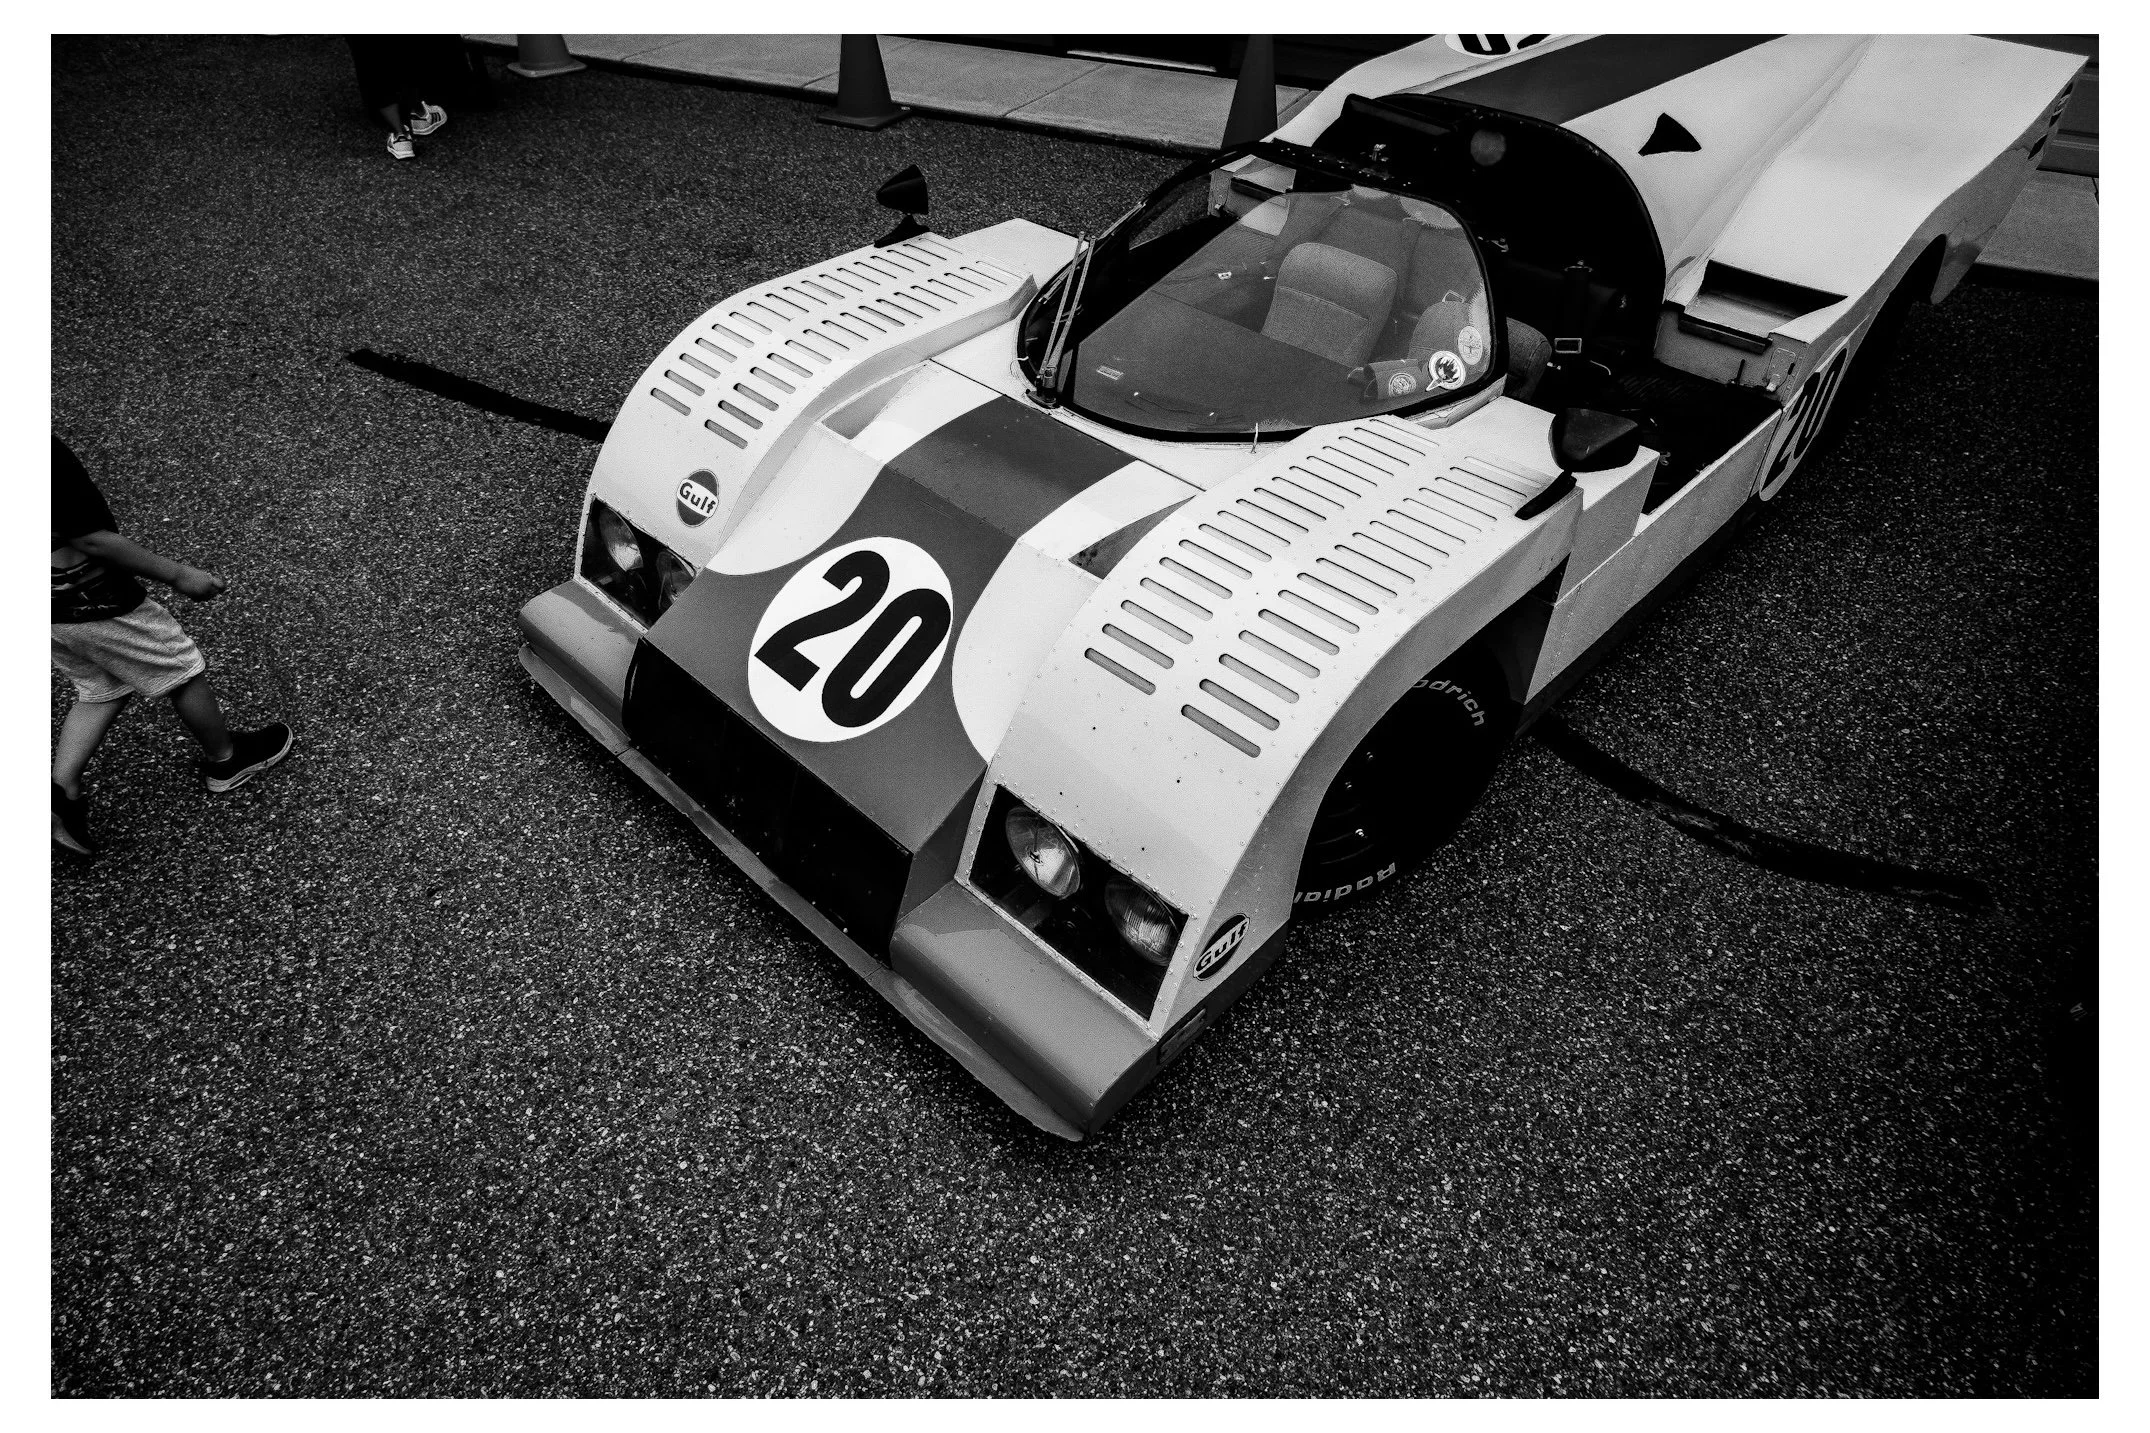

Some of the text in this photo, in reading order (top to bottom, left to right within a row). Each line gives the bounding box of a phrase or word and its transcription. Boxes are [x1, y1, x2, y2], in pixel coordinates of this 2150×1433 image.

[1761, 347, 1848, 492] 20
[680, 482, 716, 514] Gulf
[754, 550, 951, 728] 20
[1196, 921, 1248, 972] Gulf
